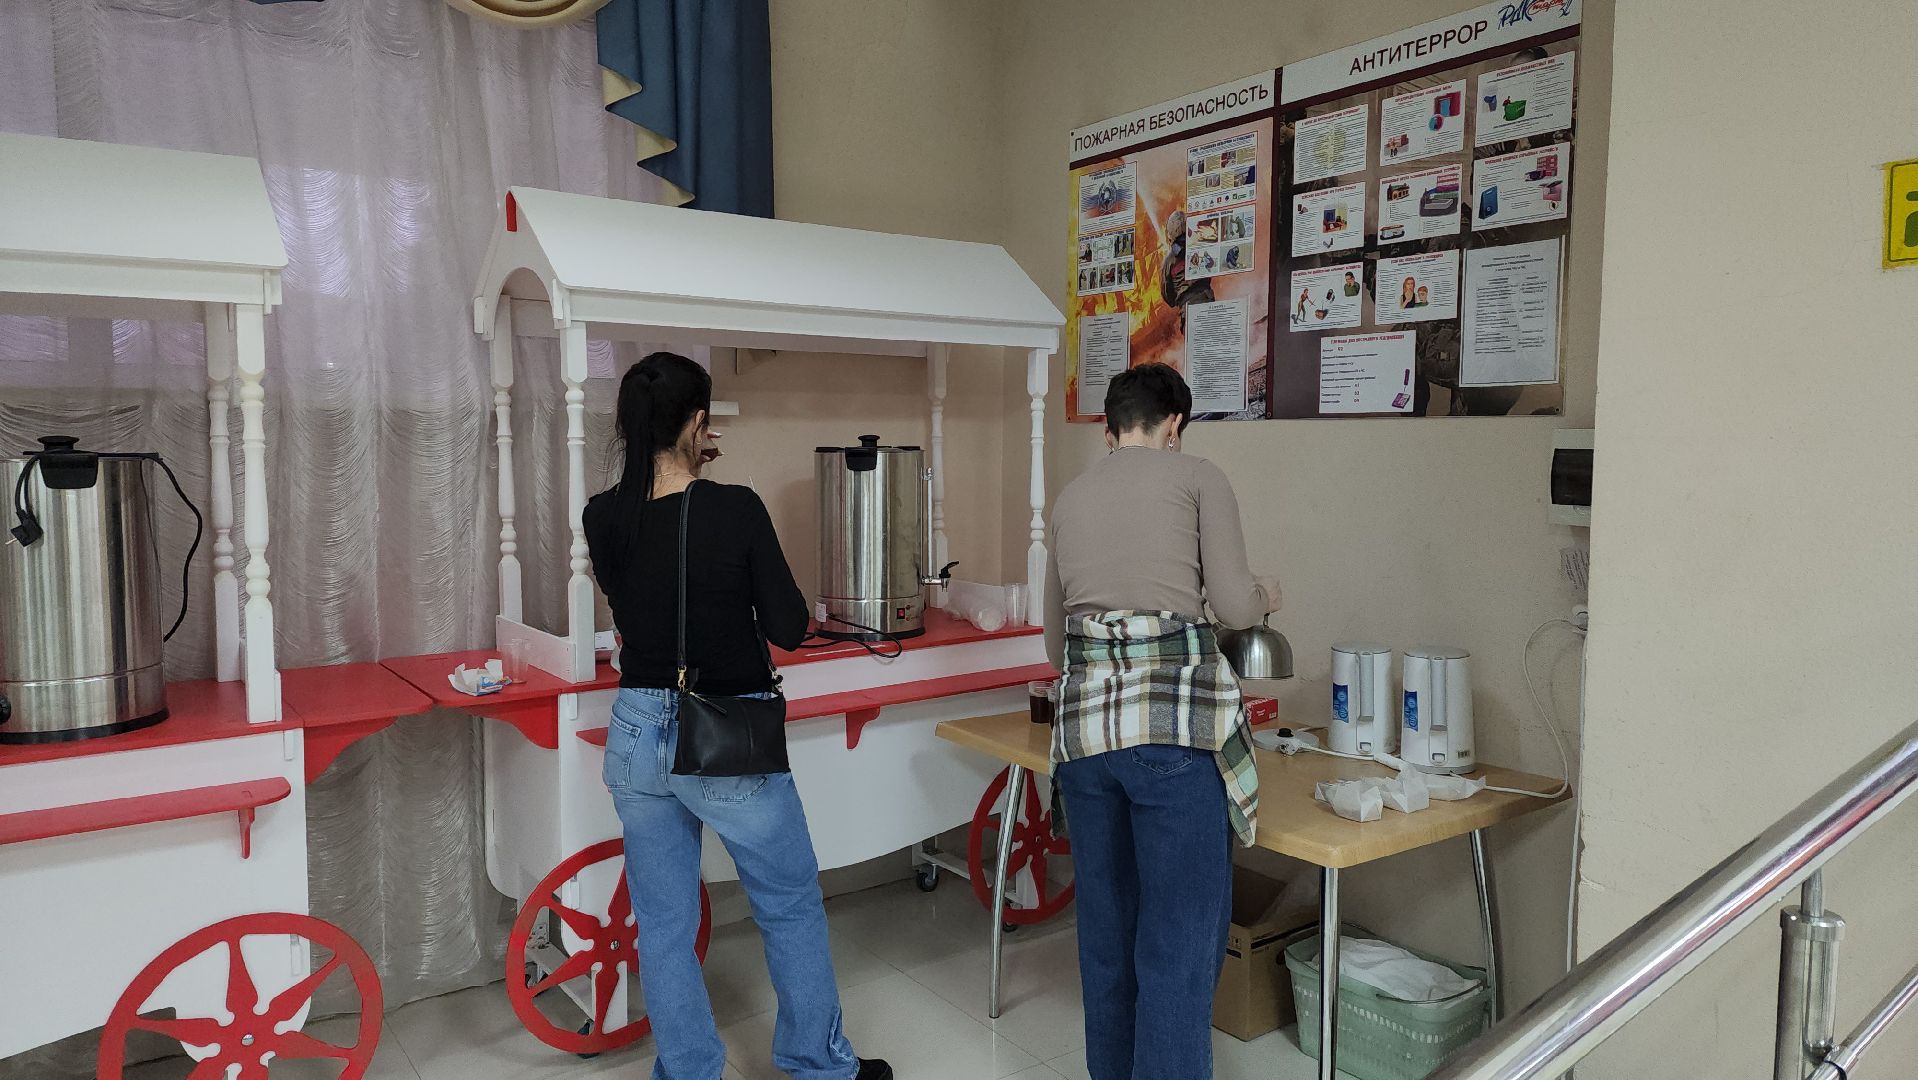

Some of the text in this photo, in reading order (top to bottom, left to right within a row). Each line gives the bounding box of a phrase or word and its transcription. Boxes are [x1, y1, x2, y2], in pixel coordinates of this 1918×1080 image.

[1349, 20, 1488, 76] АНТИТЕРРОР
[1074, 118, 1145, 152] ПОЖАРНАЯ
[1149, 83, 1269, 131] БЕЗОПАСНОСТЬ
